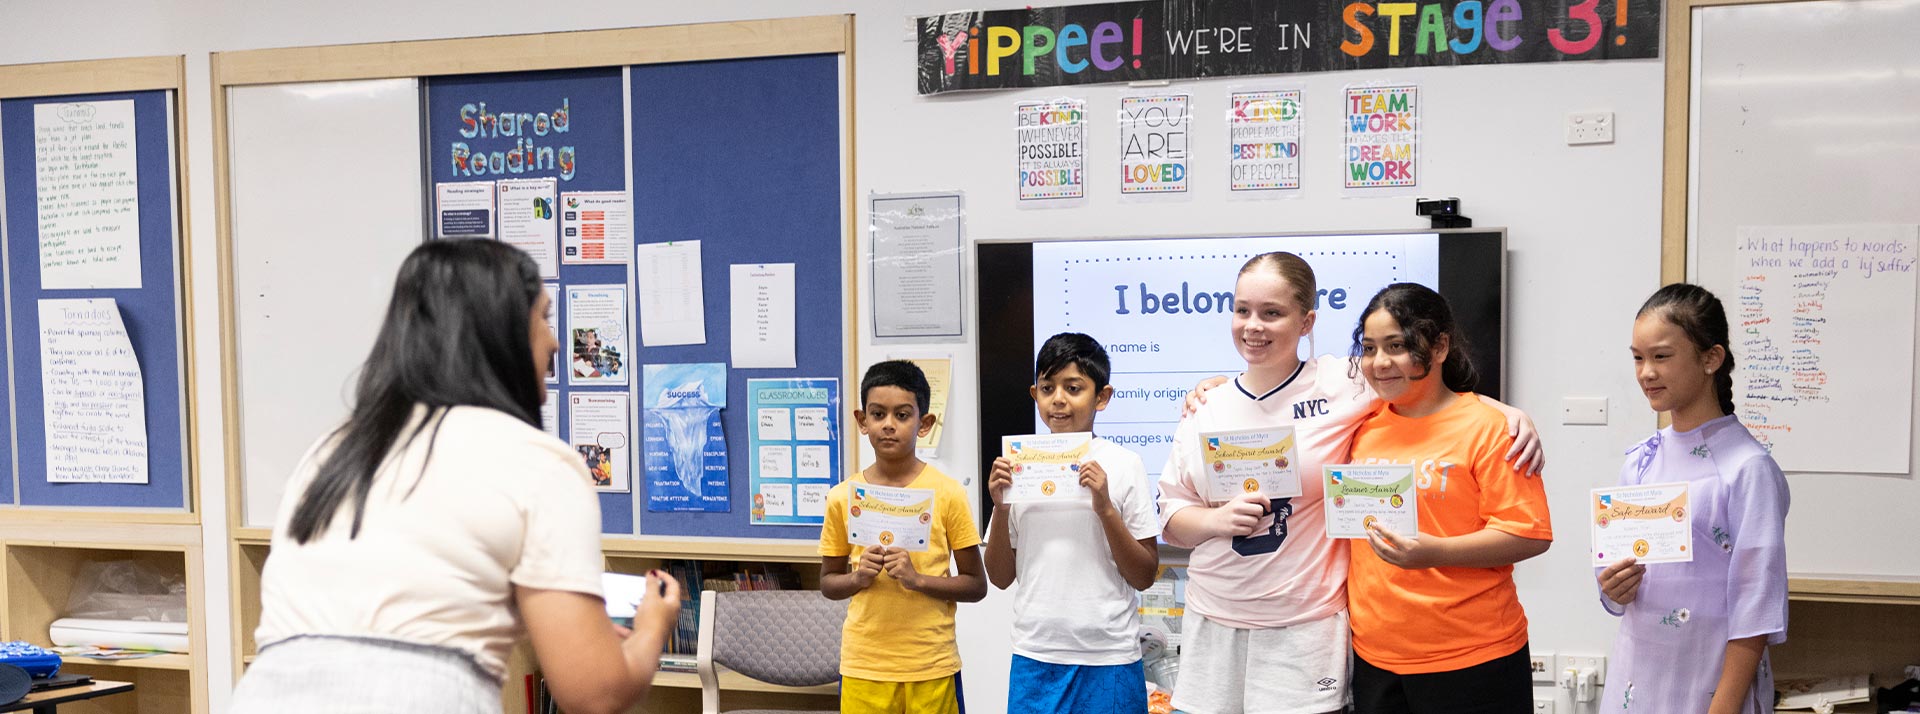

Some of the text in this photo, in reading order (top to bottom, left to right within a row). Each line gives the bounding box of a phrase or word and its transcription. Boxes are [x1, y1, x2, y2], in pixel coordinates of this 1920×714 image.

[1166, 26, 1253, 56] WE'RE
[1277, 22, 1312, 51] IN
[1234, 99, 1297, 122] KIND
[1351, 93, 1414, 113] TEAM-
[460, 98, 569, 138] Shared
[1021, 110, 1080, 126] BE KIND
[1126, 107, 1183, 128] YOU
[1351, 113, 1411, 133] WORK
[1021, 126, 1080, 143] WHENEVER
[1233, 125, 1296, 139] PEOPLE ARE THE
[1022, 143, 1081, 159] POSSIBLE.
[1124, 132, 1184, 160] ARE
[1233, 142, 1297, 159] BEST KIND
[1350, 144, 1411, 161] DREAM
[452, 138, 575, 180] Reading
[1033, 161, 1041, 169] IS
[1044, 160, 1080, 168] ALWAYS
[1021, 169, 1080, 186] POSSIBLE
[1125, 163, 1185, 183] LOVED
[1233, 163, 1297, 180] OF PEOPLE.
[1350, 161, 1412, 180] WORK
[1748, 237, 1783, 252] What
[1790, 238, 1839, 258] happens
[1845, 237, 1858, 252] to
[1751, 255, 1781, 267] when
[1789, 259, 1803, 267] we
[1812, 257, 1835, 269] add
[1842, 260, 1849, 269] a
[1115, 282, 1347, 314] I belon re
[60, 308, 111, 320] Tornadoes
[1111, 343, 1147, 352] name
[1151, 341, 1160, 352] is
[1113, 388, 1150, 400] family
[1293, 399, 1329, 419] NYC
[1214, 446, 1285, 460] School Spirit Award
[1342, 484, 1399, 495] Learner Award
[1611, 503, 1671, 520] Safe Award
